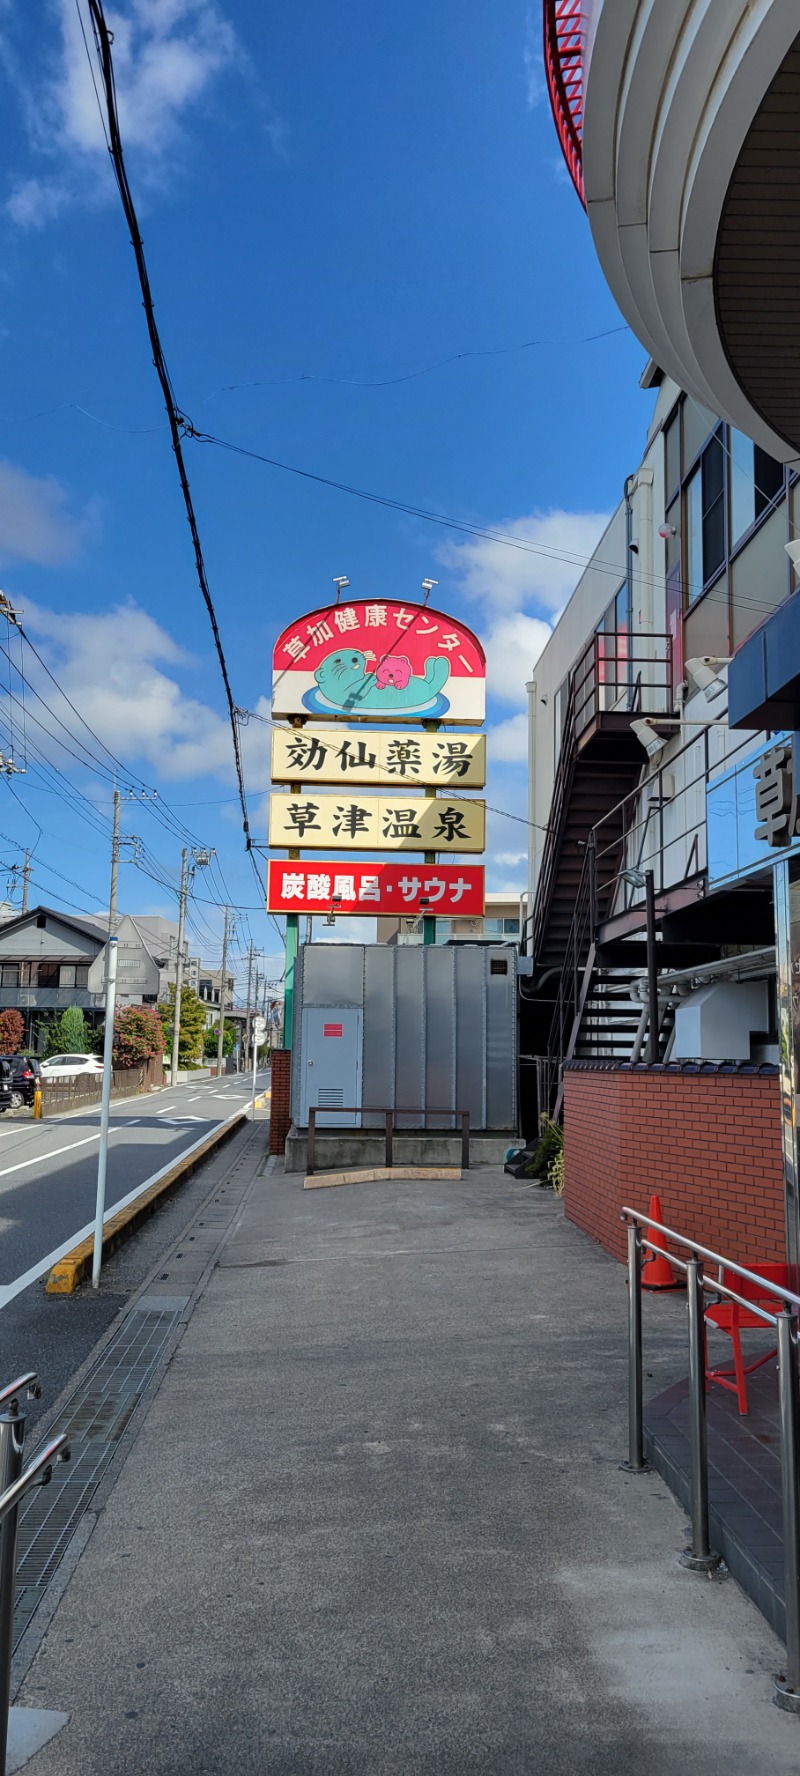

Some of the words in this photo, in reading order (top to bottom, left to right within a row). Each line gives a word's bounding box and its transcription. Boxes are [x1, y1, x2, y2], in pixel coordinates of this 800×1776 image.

[282, 604, 474, 673] 草加健康センター
[285, 738, 473, 777] 効仙薬湯
[754, 746, 800, 847] 草
[283, 802, 472, 842] 草津温泉
[280, 873, 472, 903] 炭酸風呂・サウナ
